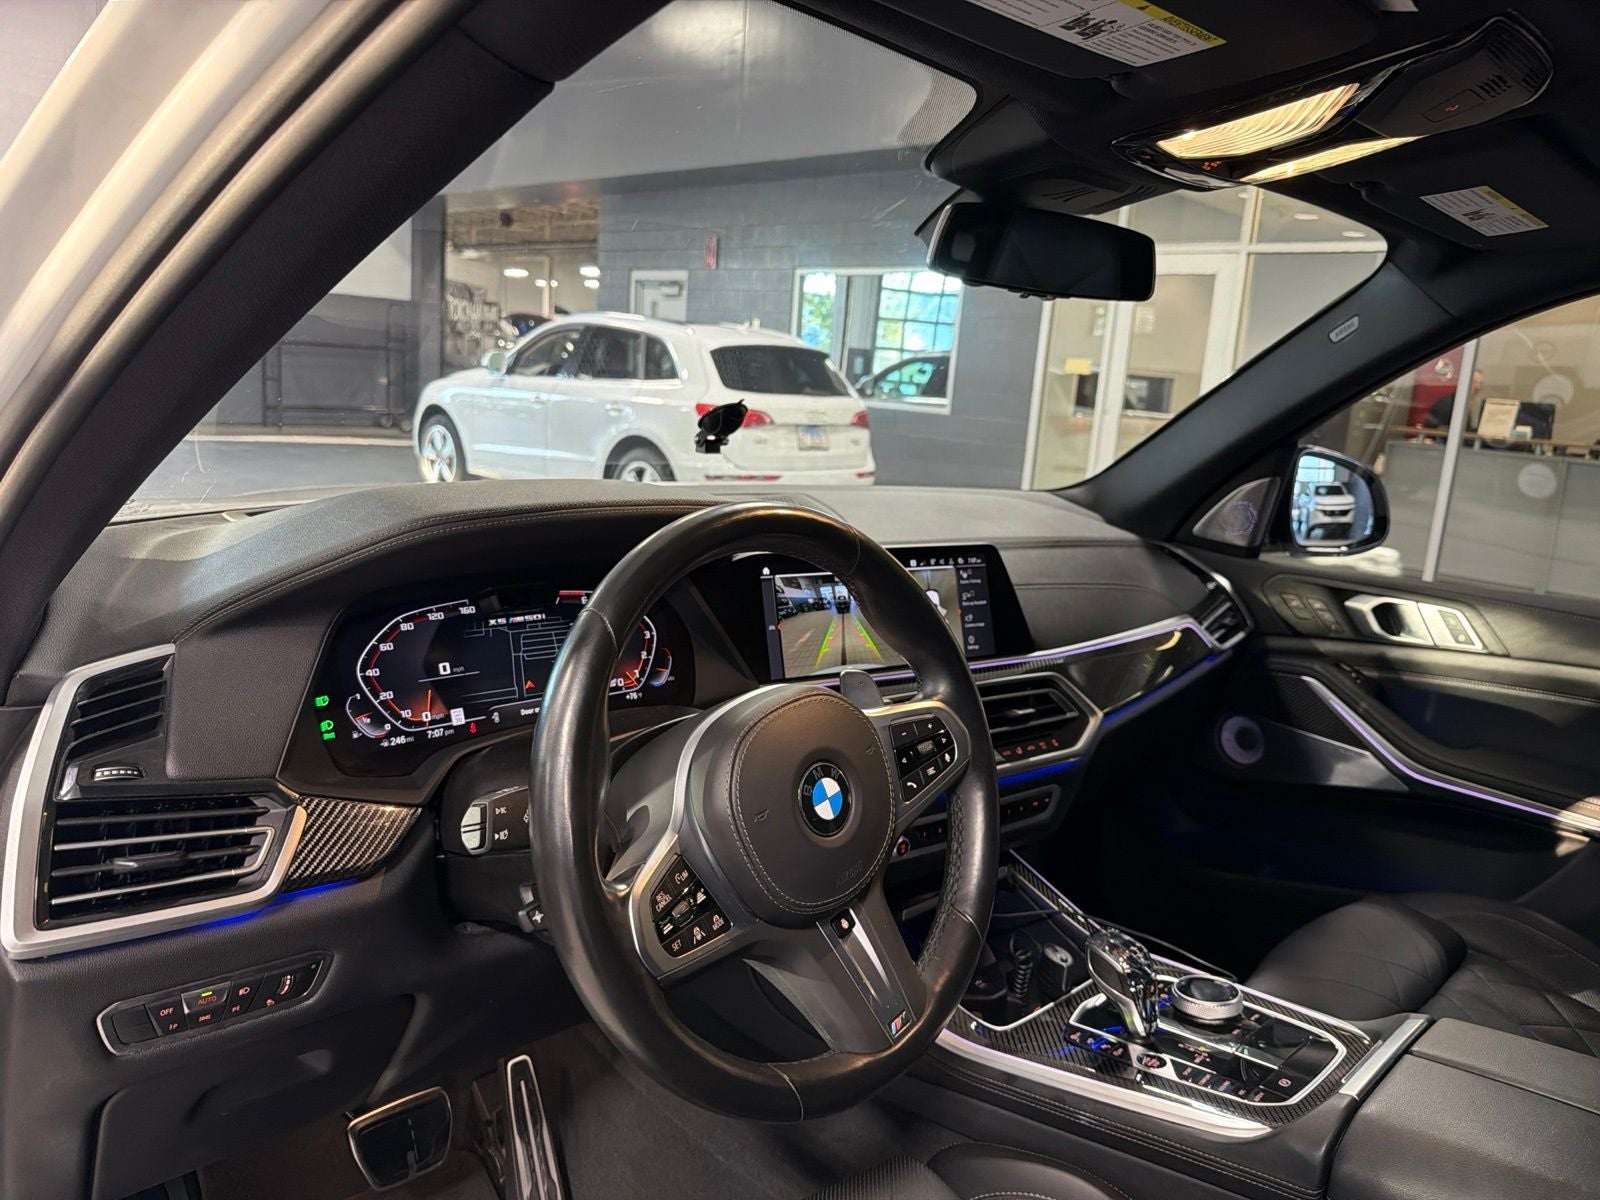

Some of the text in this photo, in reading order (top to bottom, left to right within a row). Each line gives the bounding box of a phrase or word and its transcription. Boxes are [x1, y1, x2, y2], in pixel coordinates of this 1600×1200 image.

[459, 606, 476, 614] 160
[427, 612, 444, 620] 120
[400, 622, 414, 631] 80
[644, 630, 650, 639] 3
[380, 642, 394, 651] 60
[641, 651, 648, 659] 2
[365, 668, 380, 677] 40
[438, 662, 451, 675] 0
[379, 690, 394, 700] 20
[400, 709, 412, 718] 10
[422, 712, 431, 722] 0
[426, 728, 445, 739] 7:07
[389, 735, 407, 746] 246
[803, 766, 840, 797] BMW
[671, 938, 682, 952] SET
[197, 995, 217, 1006] AUTO
[159, 1007, 174, 1017] OFF
